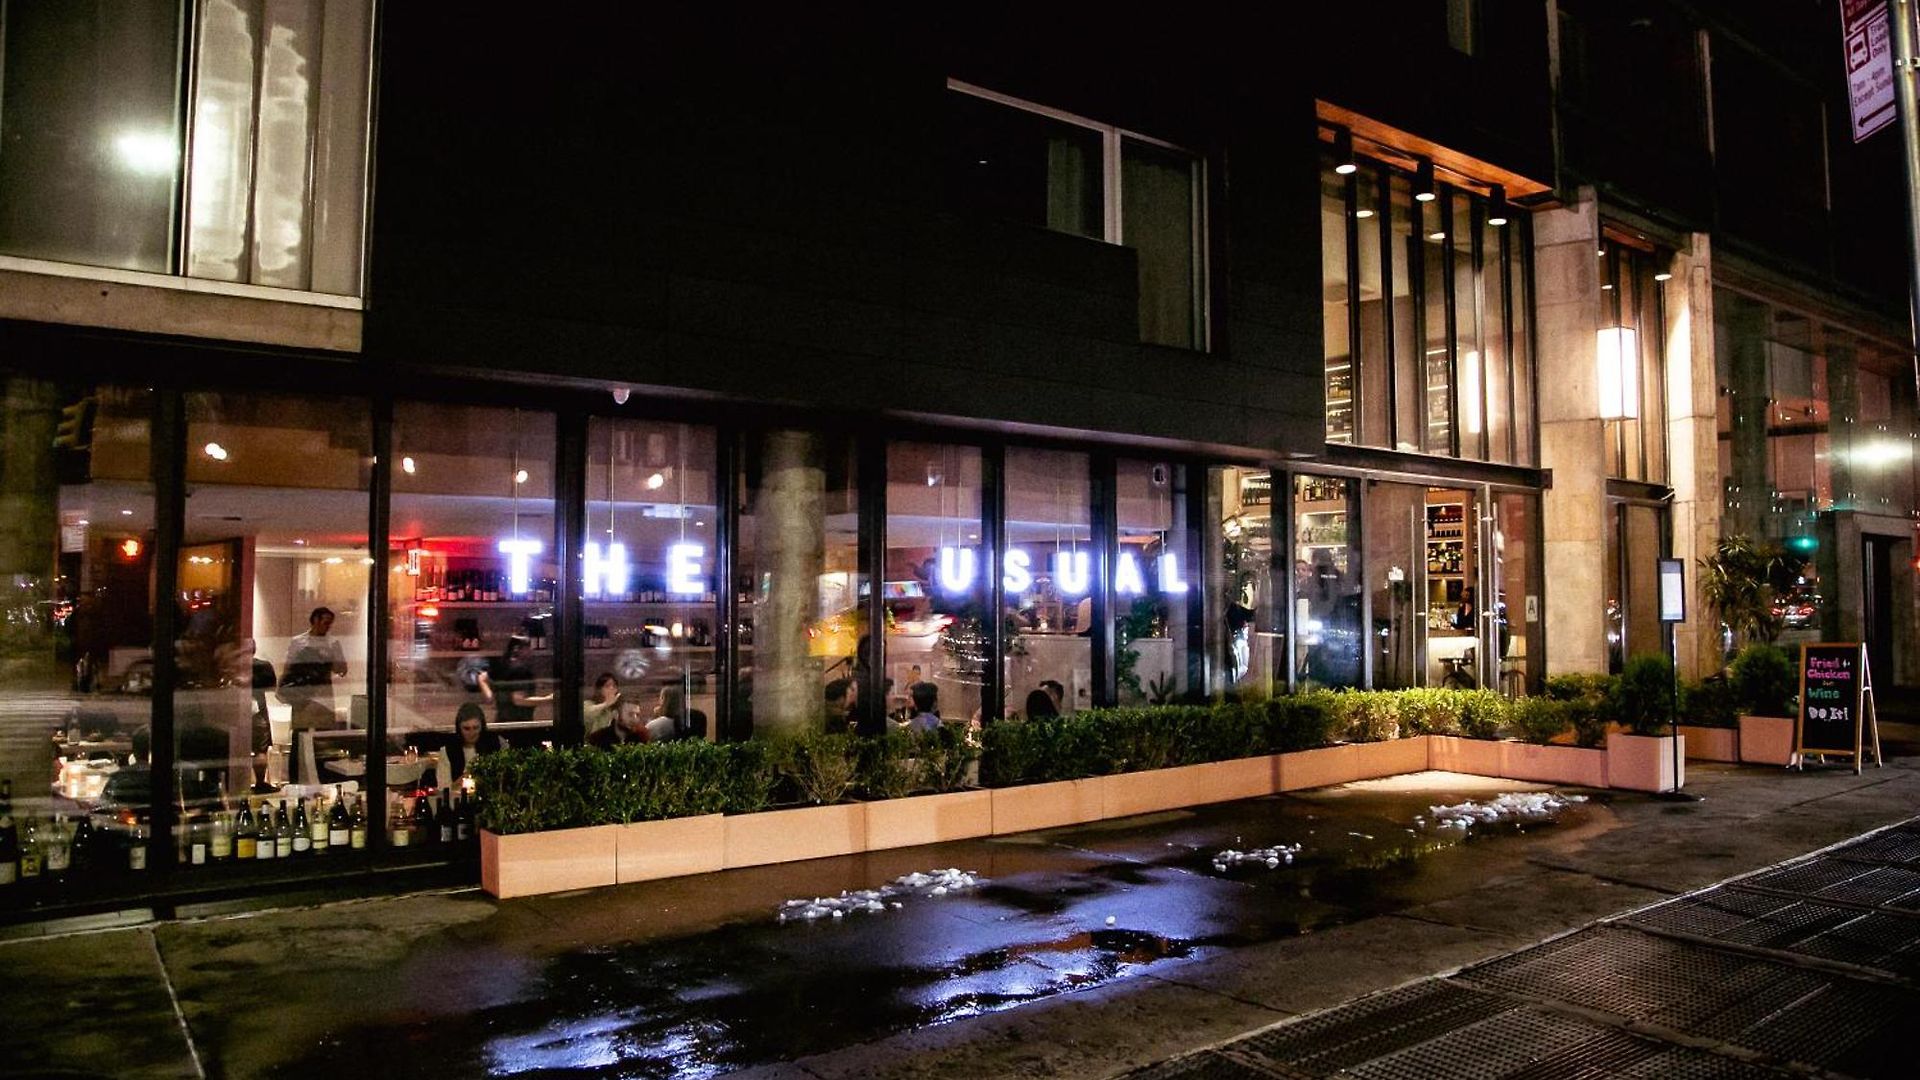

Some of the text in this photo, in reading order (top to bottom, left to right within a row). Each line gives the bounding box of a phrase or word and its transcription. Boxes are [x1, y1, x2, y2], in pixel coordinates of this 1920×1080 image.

[497, 540, 1188, 594] THE USUAL
[1527, 599, 1536, 615] A
[1810, 657, 1840, 669] Fried
[1807, 669, 1850, 679] Chicken
[1808, 687, 1840, 699] Wine
